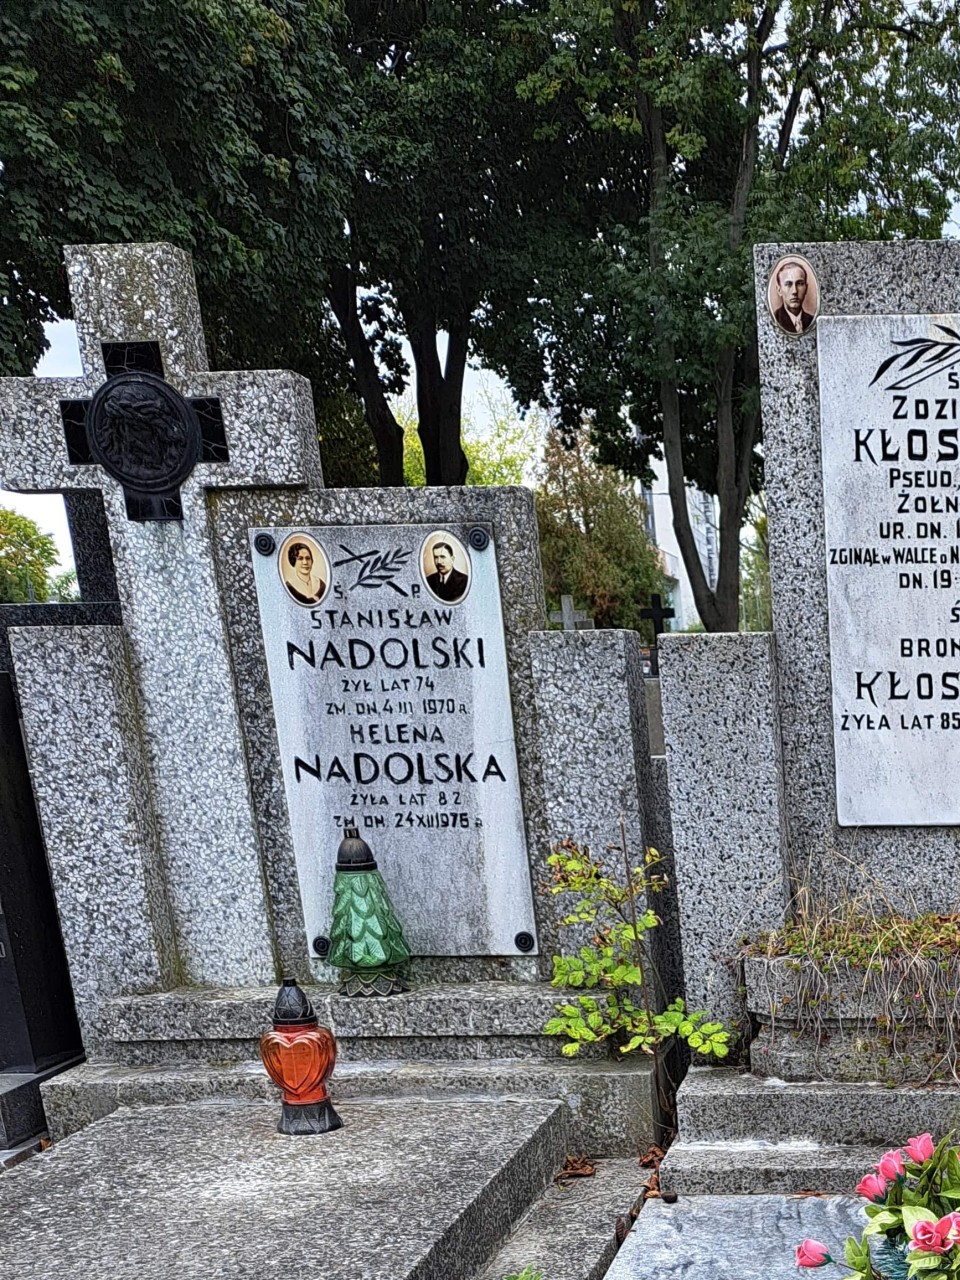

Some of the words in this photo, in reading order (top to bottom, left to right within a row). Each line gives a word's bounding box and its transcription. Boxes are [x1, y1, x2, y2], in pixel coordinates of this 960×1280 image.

[879, 522, 911, 539] UR.
[916, 522, 947, 539] DN.
[829, 547, 880, 567] ZGINĄŁ
[892, 547, 937, 564] WALCE
[899, 572, 928, 589] DN.
[311, 609, 452, 629] STANISŁAW
[286, 636, 486, 670] NADOLSKI
[341, 675, 372, 692] ŻYŁ
[381, 678, 411, 691] LAT
[415, 676, 435, 691] 74
[423, 698, 455, 715] 1970
[841, 708, 891, 731] ŻYŁA
[900, 714, 934, 730] LAT
[350, 723, 445, 744] HELENA
[294, 752, 507, 785] NADOLSKA
[399, 793, 427, 806] LAT
